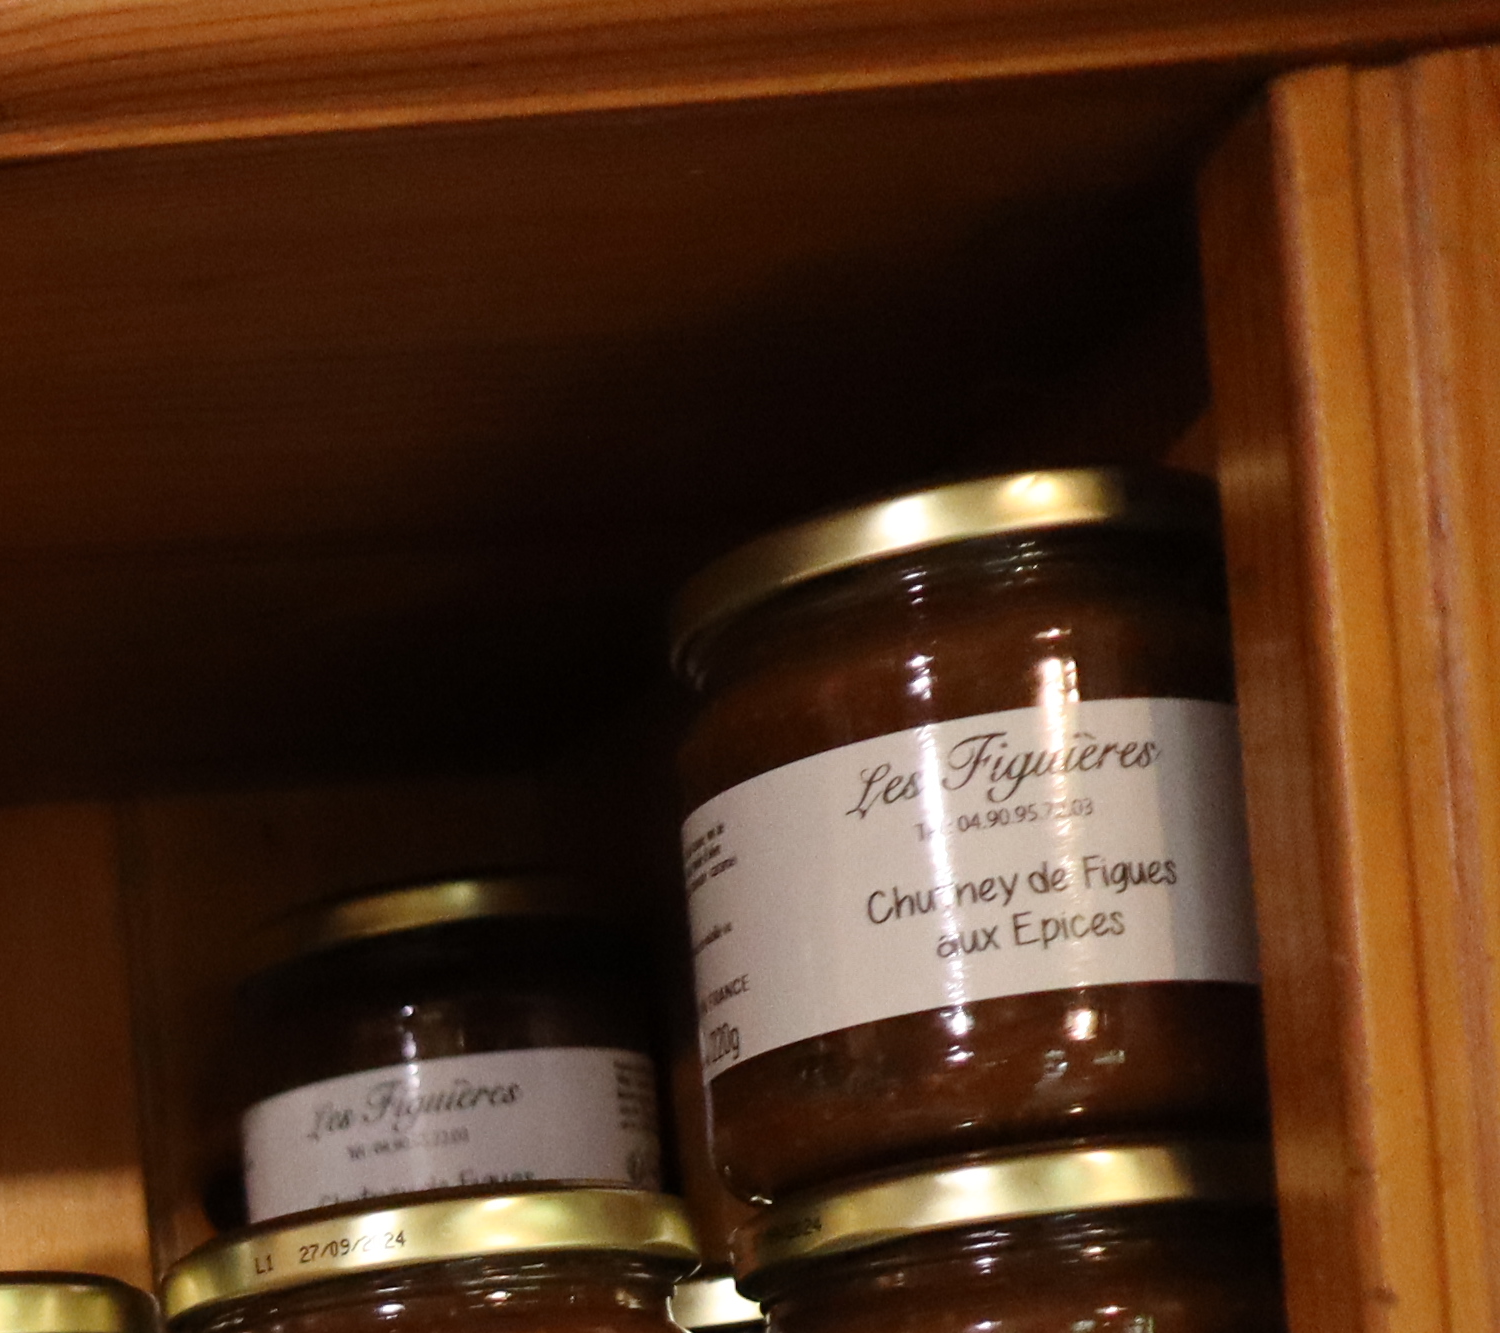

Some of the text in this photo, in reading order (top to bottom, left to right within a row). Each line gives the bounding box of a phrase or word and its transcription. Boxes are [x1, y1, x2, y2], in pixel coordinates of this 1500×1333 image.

[936, 909, 1125, 960] aux Epices
[299, 1231, 406, 1265] 27/09/224
